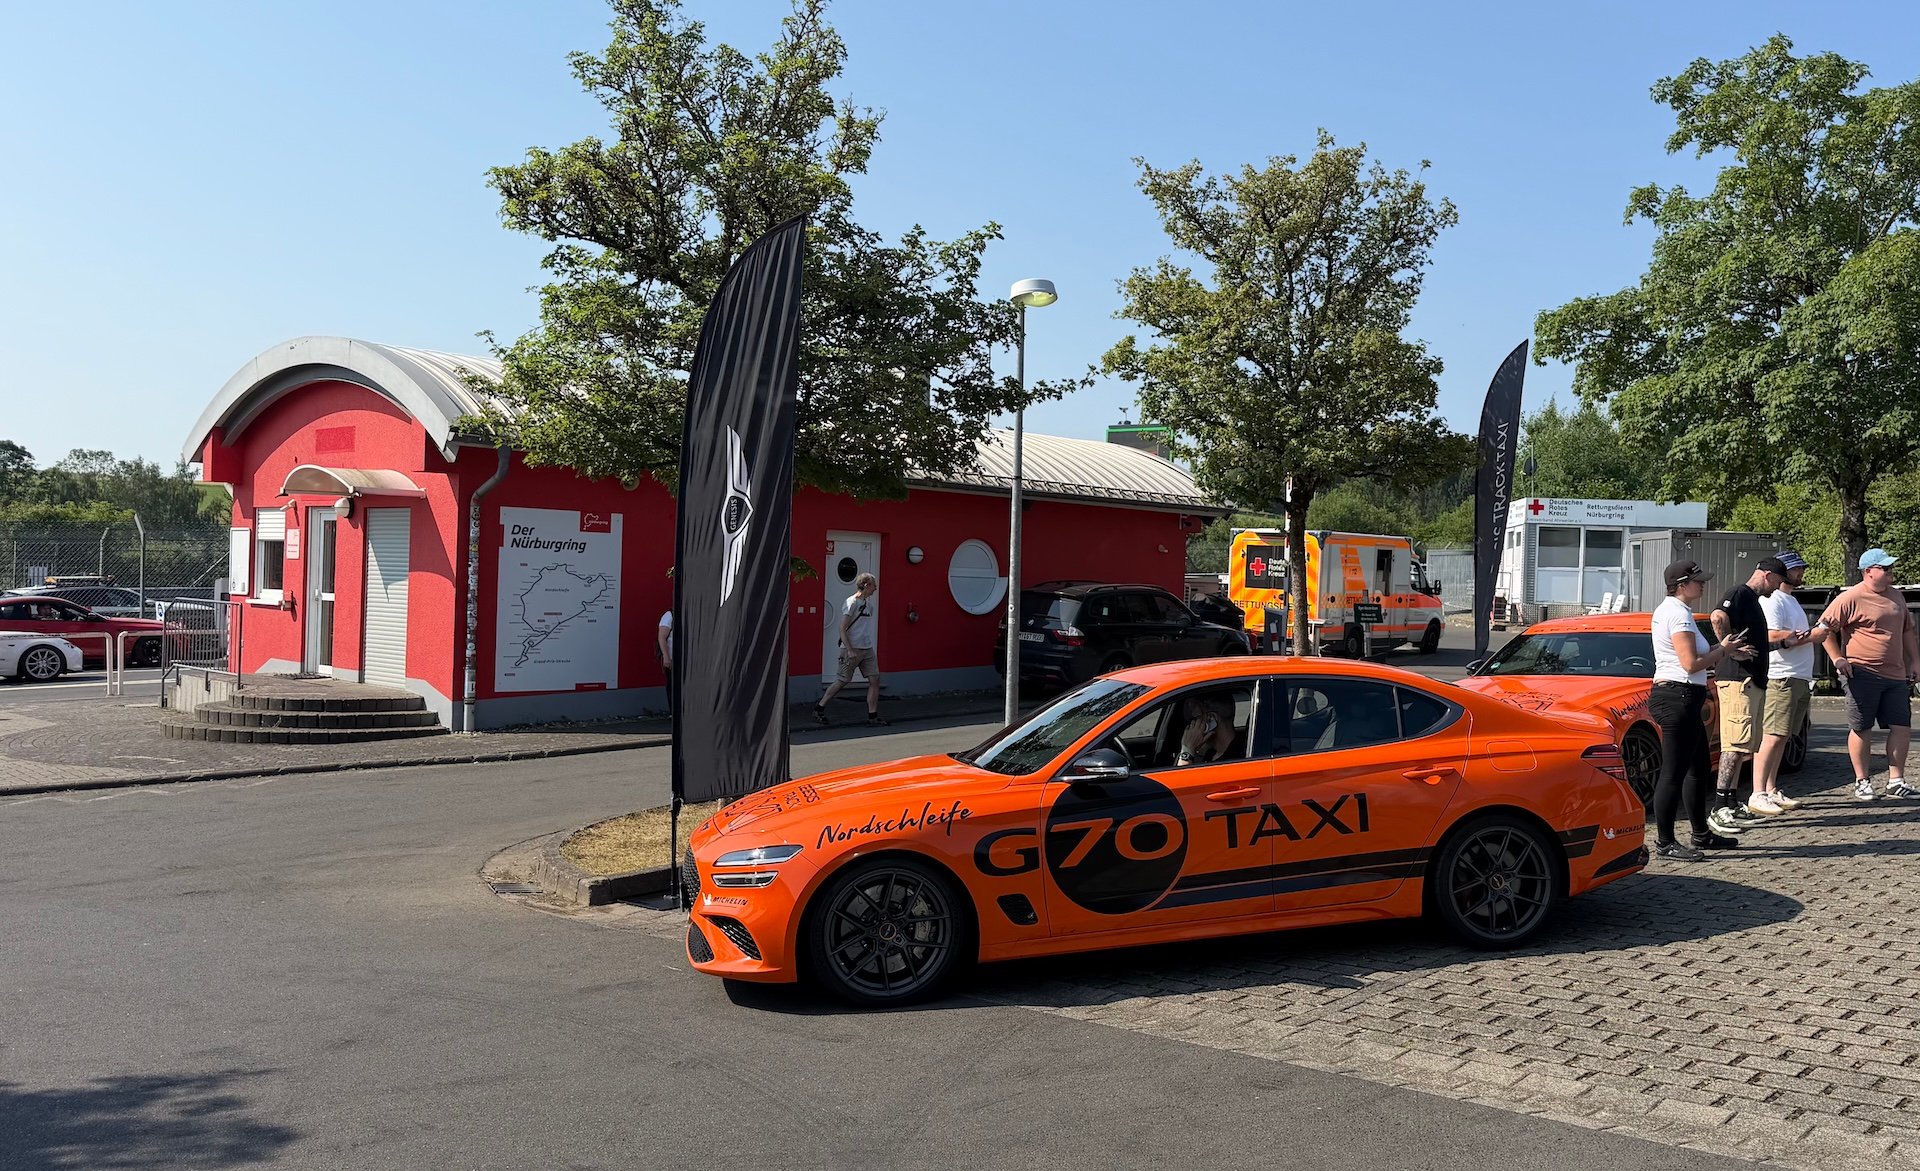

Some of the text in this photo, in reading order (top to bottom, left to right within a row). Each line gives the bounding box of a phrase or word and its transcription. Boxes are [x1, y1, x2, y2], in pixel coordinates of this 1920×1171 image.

[1586, 503, 1633, 511] Rettungsdienst
[730, 499, 738, 530] GENESIS
[511, 524, 535, 536] Der
[510, 537, 587, 554] Nürburgring
[1737, 551, 1748, 559] 29
[816, 801, 973, 849] Nordschleife
[973, 792, 1369, 877] G70 TAXI
[713, 896, 749, 906] MICHELIN
